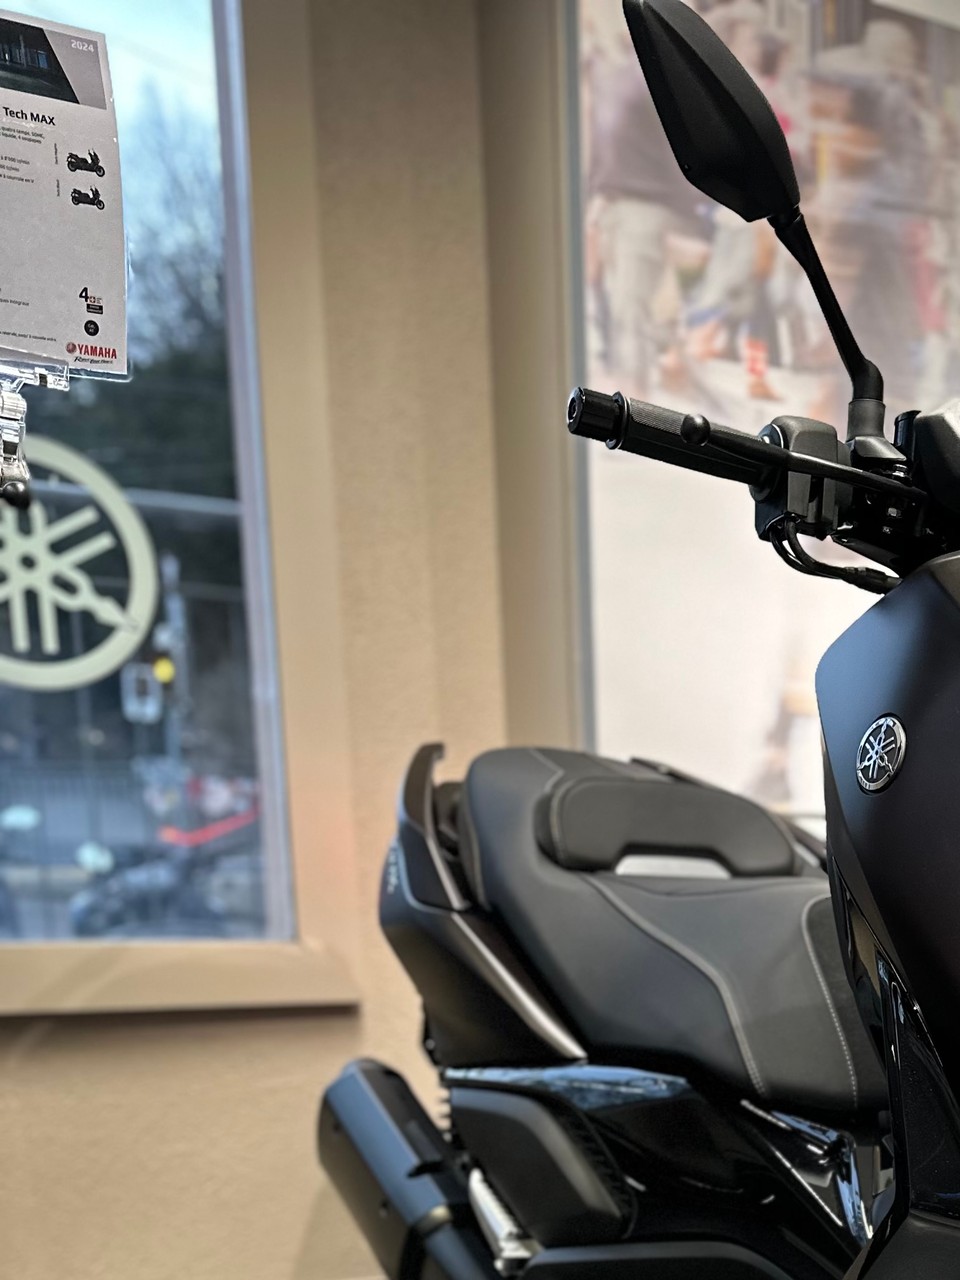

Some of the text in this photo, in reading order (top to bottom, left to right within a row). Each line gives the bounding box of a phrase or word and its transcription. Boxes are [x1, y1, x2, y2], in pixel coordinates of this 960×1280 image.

[70, 39, 95, 53] 2024
[3, 106, 56, 126] Tech MAX
[77, 343, 117, 359] YAMAHA
